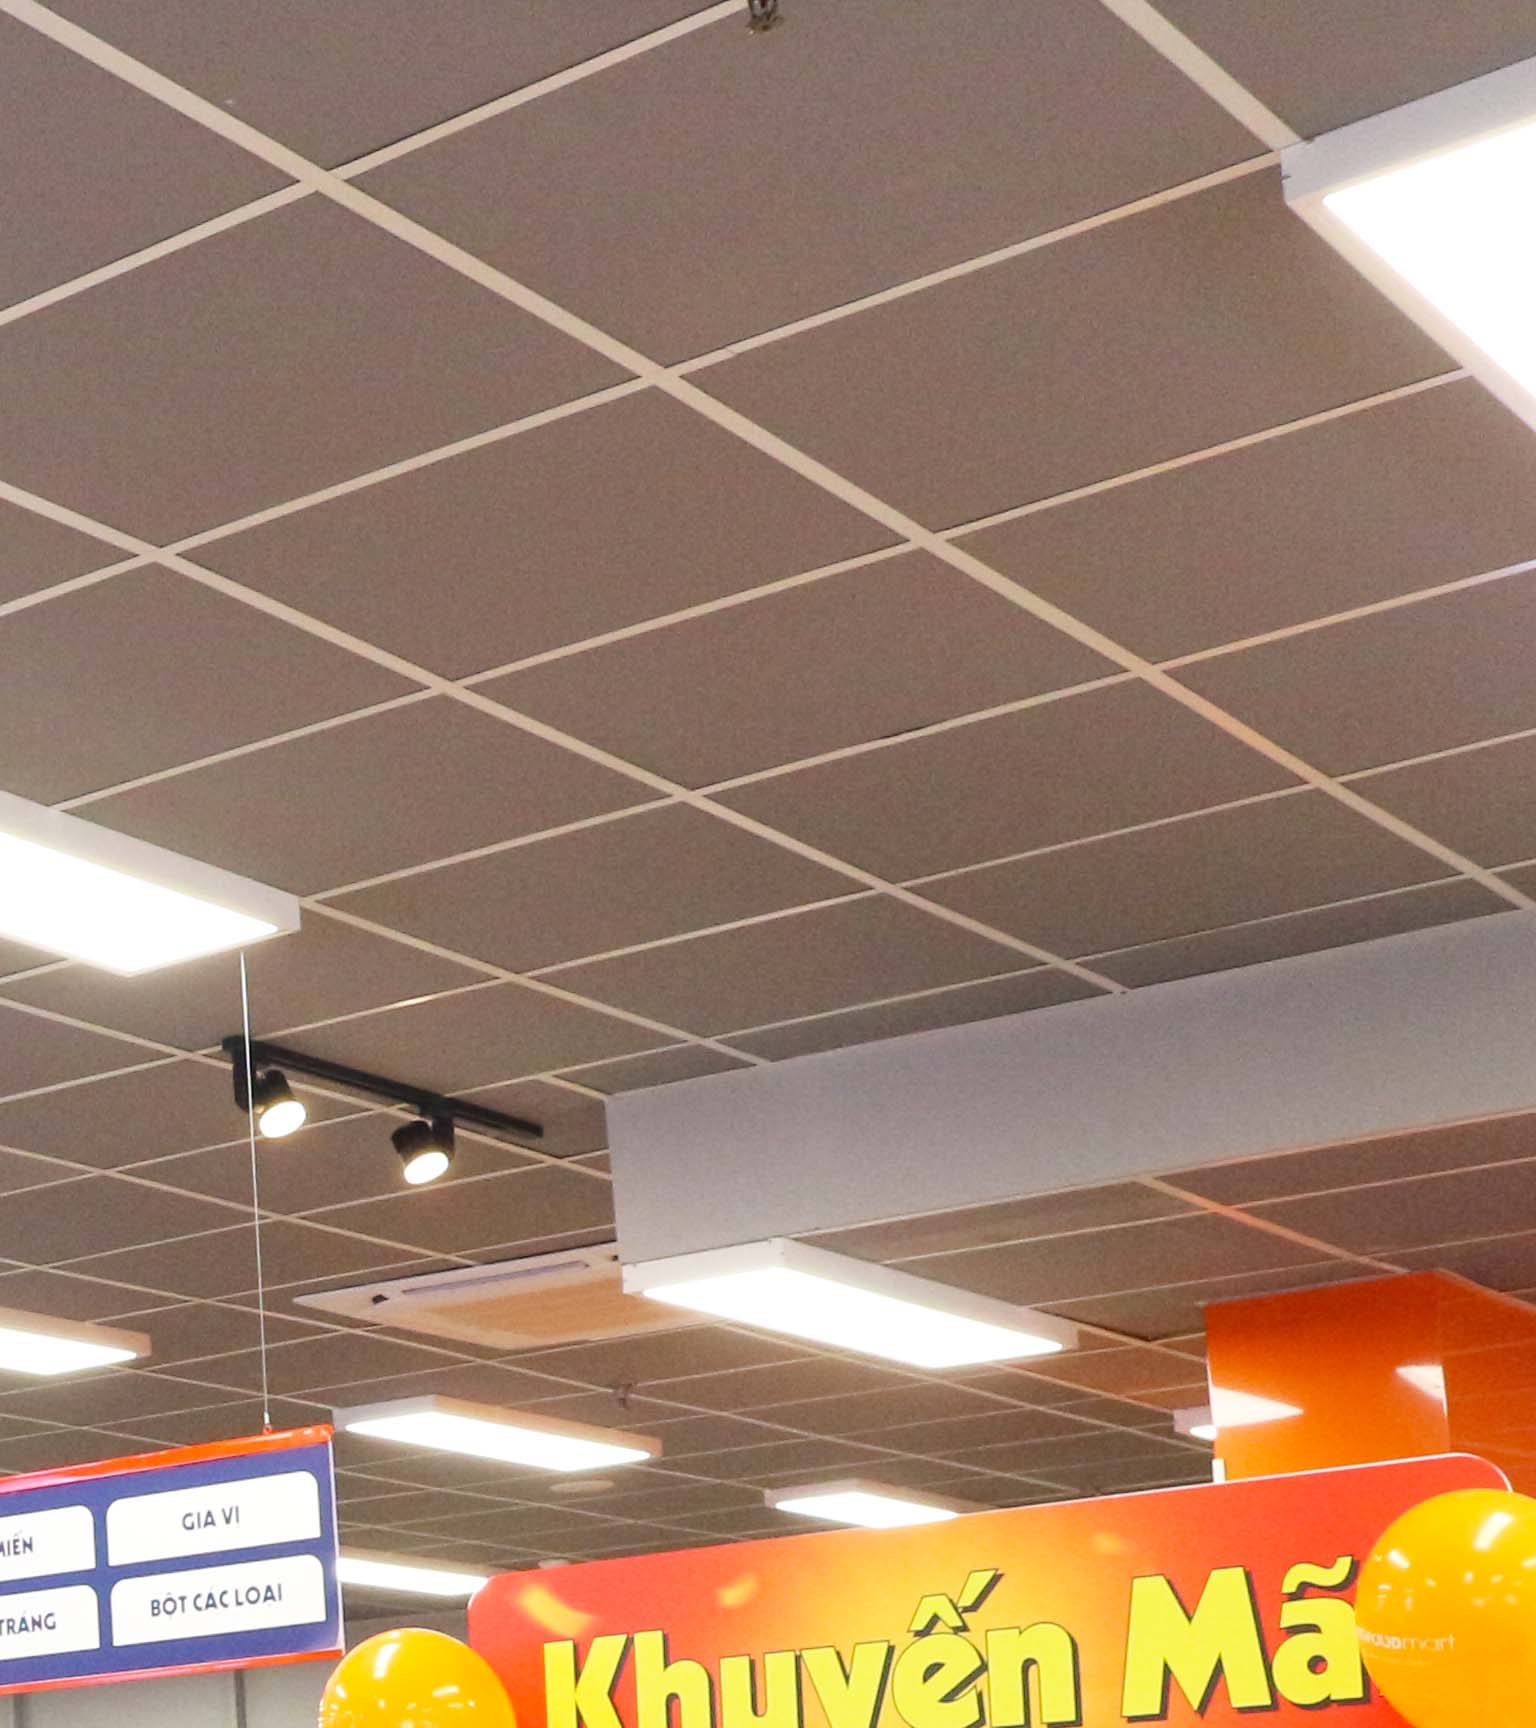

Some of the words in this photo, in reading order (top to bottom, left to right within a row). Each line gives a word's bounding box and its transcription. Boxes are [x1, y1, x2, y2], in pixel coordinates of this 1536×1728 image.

[182, 1510, 216, 1530] GIA
[150, 1592, 187, 1621] BỘT
[193, 1586, 228, 1612] CÁC
[1121, 1555, 1370, 1721] Mã
